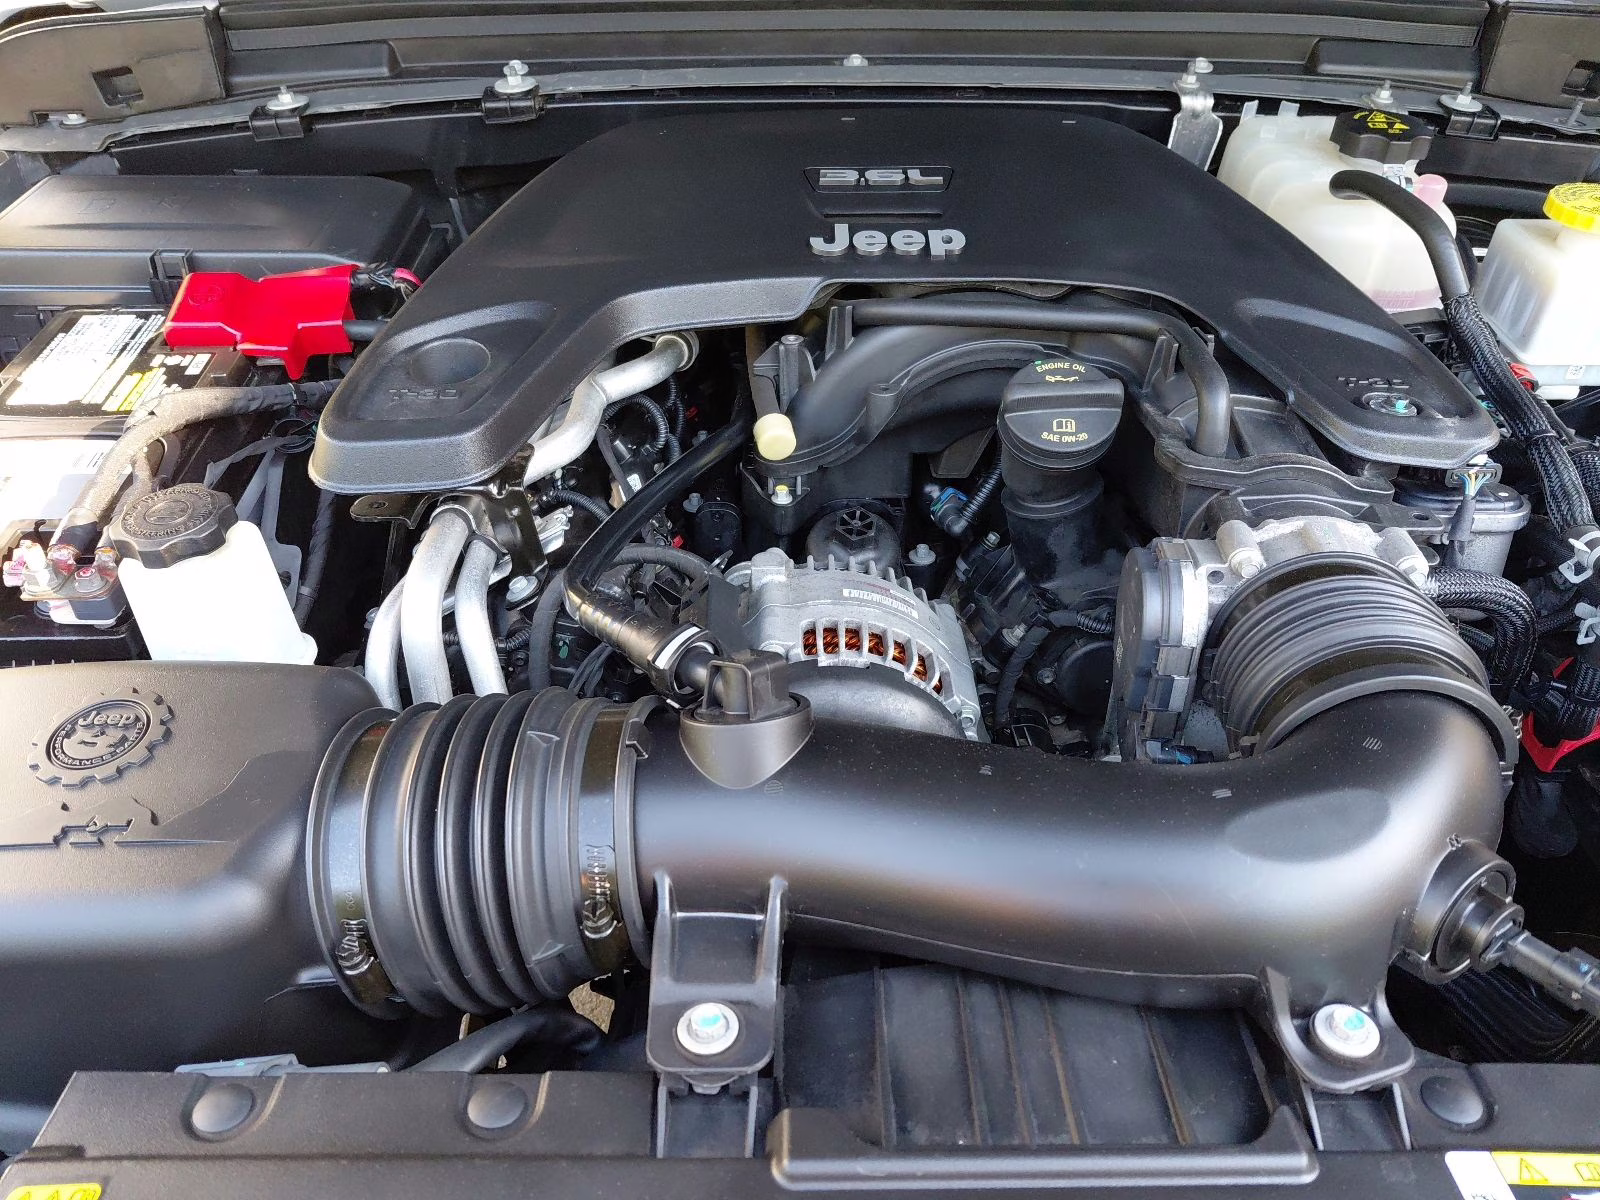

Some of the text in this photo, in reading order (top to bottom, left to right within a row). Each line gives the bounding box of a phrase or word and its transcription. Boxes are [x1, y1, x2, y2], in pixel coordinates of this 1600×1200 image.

[819, 169, 944, 186] 3.6L
[809, 223, 966, 261] Jeep
[1035, 362, 1087, 373] ENGINE OIL
[1041, 432, 1088, 443] SAE 0W-20
[78, 711, 139, 728] Jeep
[54, 721, 144, 766] PERFORMANCE PARTS
